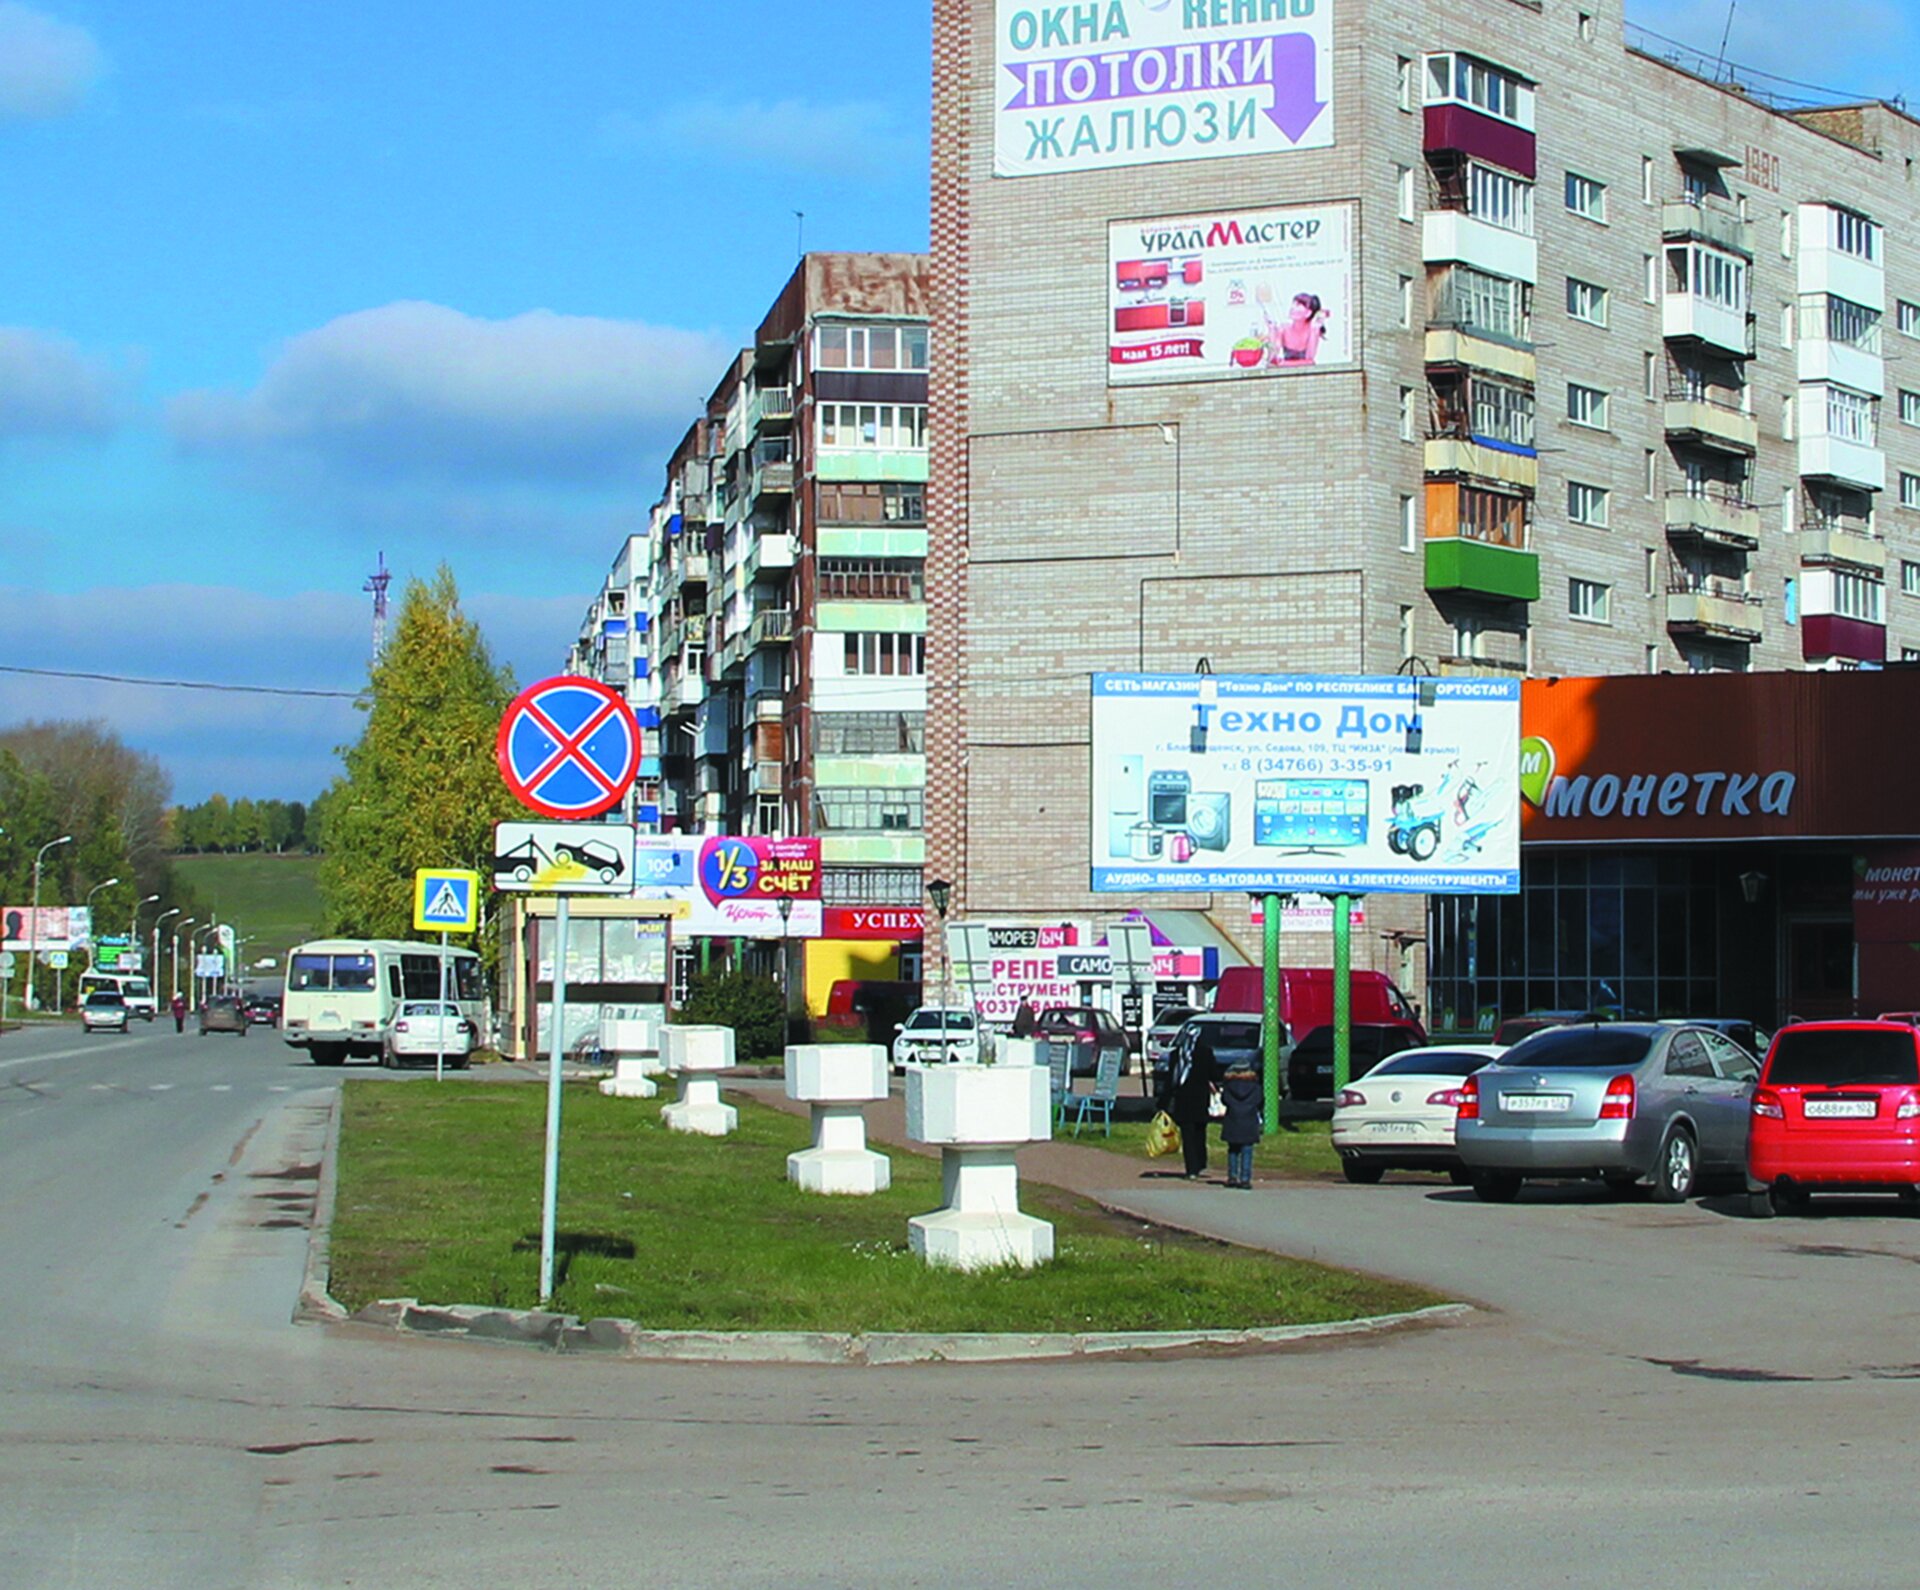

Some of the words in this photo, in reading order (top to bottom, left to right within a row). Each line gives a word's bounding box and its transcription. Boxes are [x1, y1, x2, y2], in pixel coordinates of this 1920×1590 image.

[1009, 0, 1130, 51] ОКНА
[1026, 37, 1274, 106] ПОТОЛКИ
[1025, 98, 1256, 160] ЖАЛЮЗИ
[1121, 348, 1148, 361] нам
[1150, 345, 1163, 357] 15
[1164, 341, 1190, 355] лет!
[1104, 679, 1141, 691] СЕТЬ
[1142, 680, 1216, 692] МАГАЗИН
[1295, 682, 1313, 693] ПО
[1315, 682, 1394, 695] РЕСПУБЛИКЕ
[1397, 683, 1509, 696] БАОРТОСТАН
[1192, 703, 1322, 733] Техно
[1336, 705, 1423, 739] Дом
[1308, 744, 1329, 754] 109,
[1240, 758, 1251, 772] 8
[1257, 758, 1324, 774] (34766)
[1330, 758, 1392, 773] 3-35-91
[1545, 770, 1797, 818] монетка
[646, 858, 674, 873] 100
[779, 859, 814, 872] НАШ
[758, 871, 813, 892] СЧЁТ
[1104, 873, 1155, 885] АУДИО-
[1156, 873, 1207, 886] ВИДЕО-
[1208, 873, 1273, 886] БЫТОВАЯ
[1275, 873, 1337, 886] ТЕХНИКА
[1338, 874, 1349, 885] И
[1351, 874, 1508, 887] ЭЛЕКТРОИНСТРУМЕНТЫ
[852, 912, 926, 929] УСПЕХ
